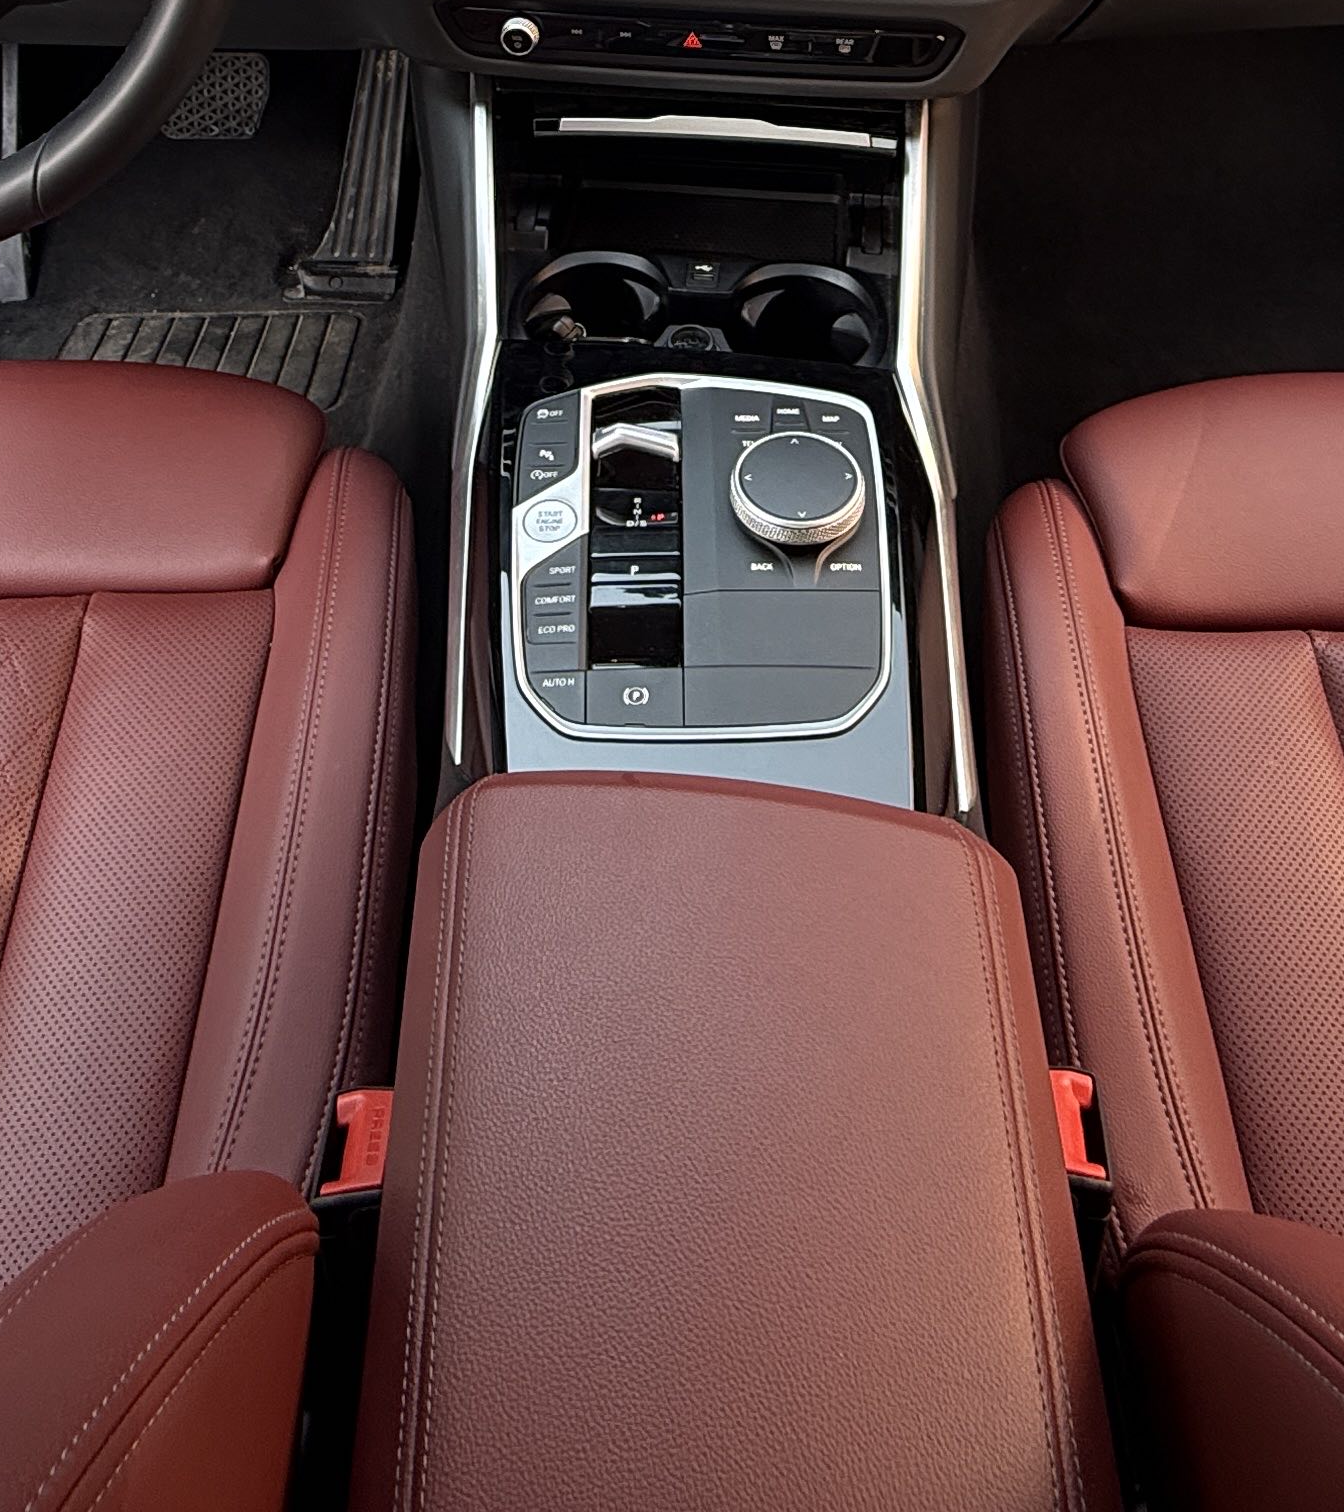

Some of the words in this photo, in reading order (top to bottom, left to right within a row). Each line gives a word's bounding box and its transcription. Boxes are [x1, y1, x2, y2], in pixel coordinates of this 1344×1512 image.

[549, 409, 564, 417] OFF
[548, 565, 576, 575] SPORT
[630, 565, 639, 575] P
[750, 562, 774, 571] BACK
[829, 562, 863, 572] OPTION
[534, 594, 576, 605] COMFORT
[537, 625, 556, 634] ECO
[557, 624, 575, 634] PRO
[542, 678, 566, 688] AUTO
[567, 677, 575, 686] H
